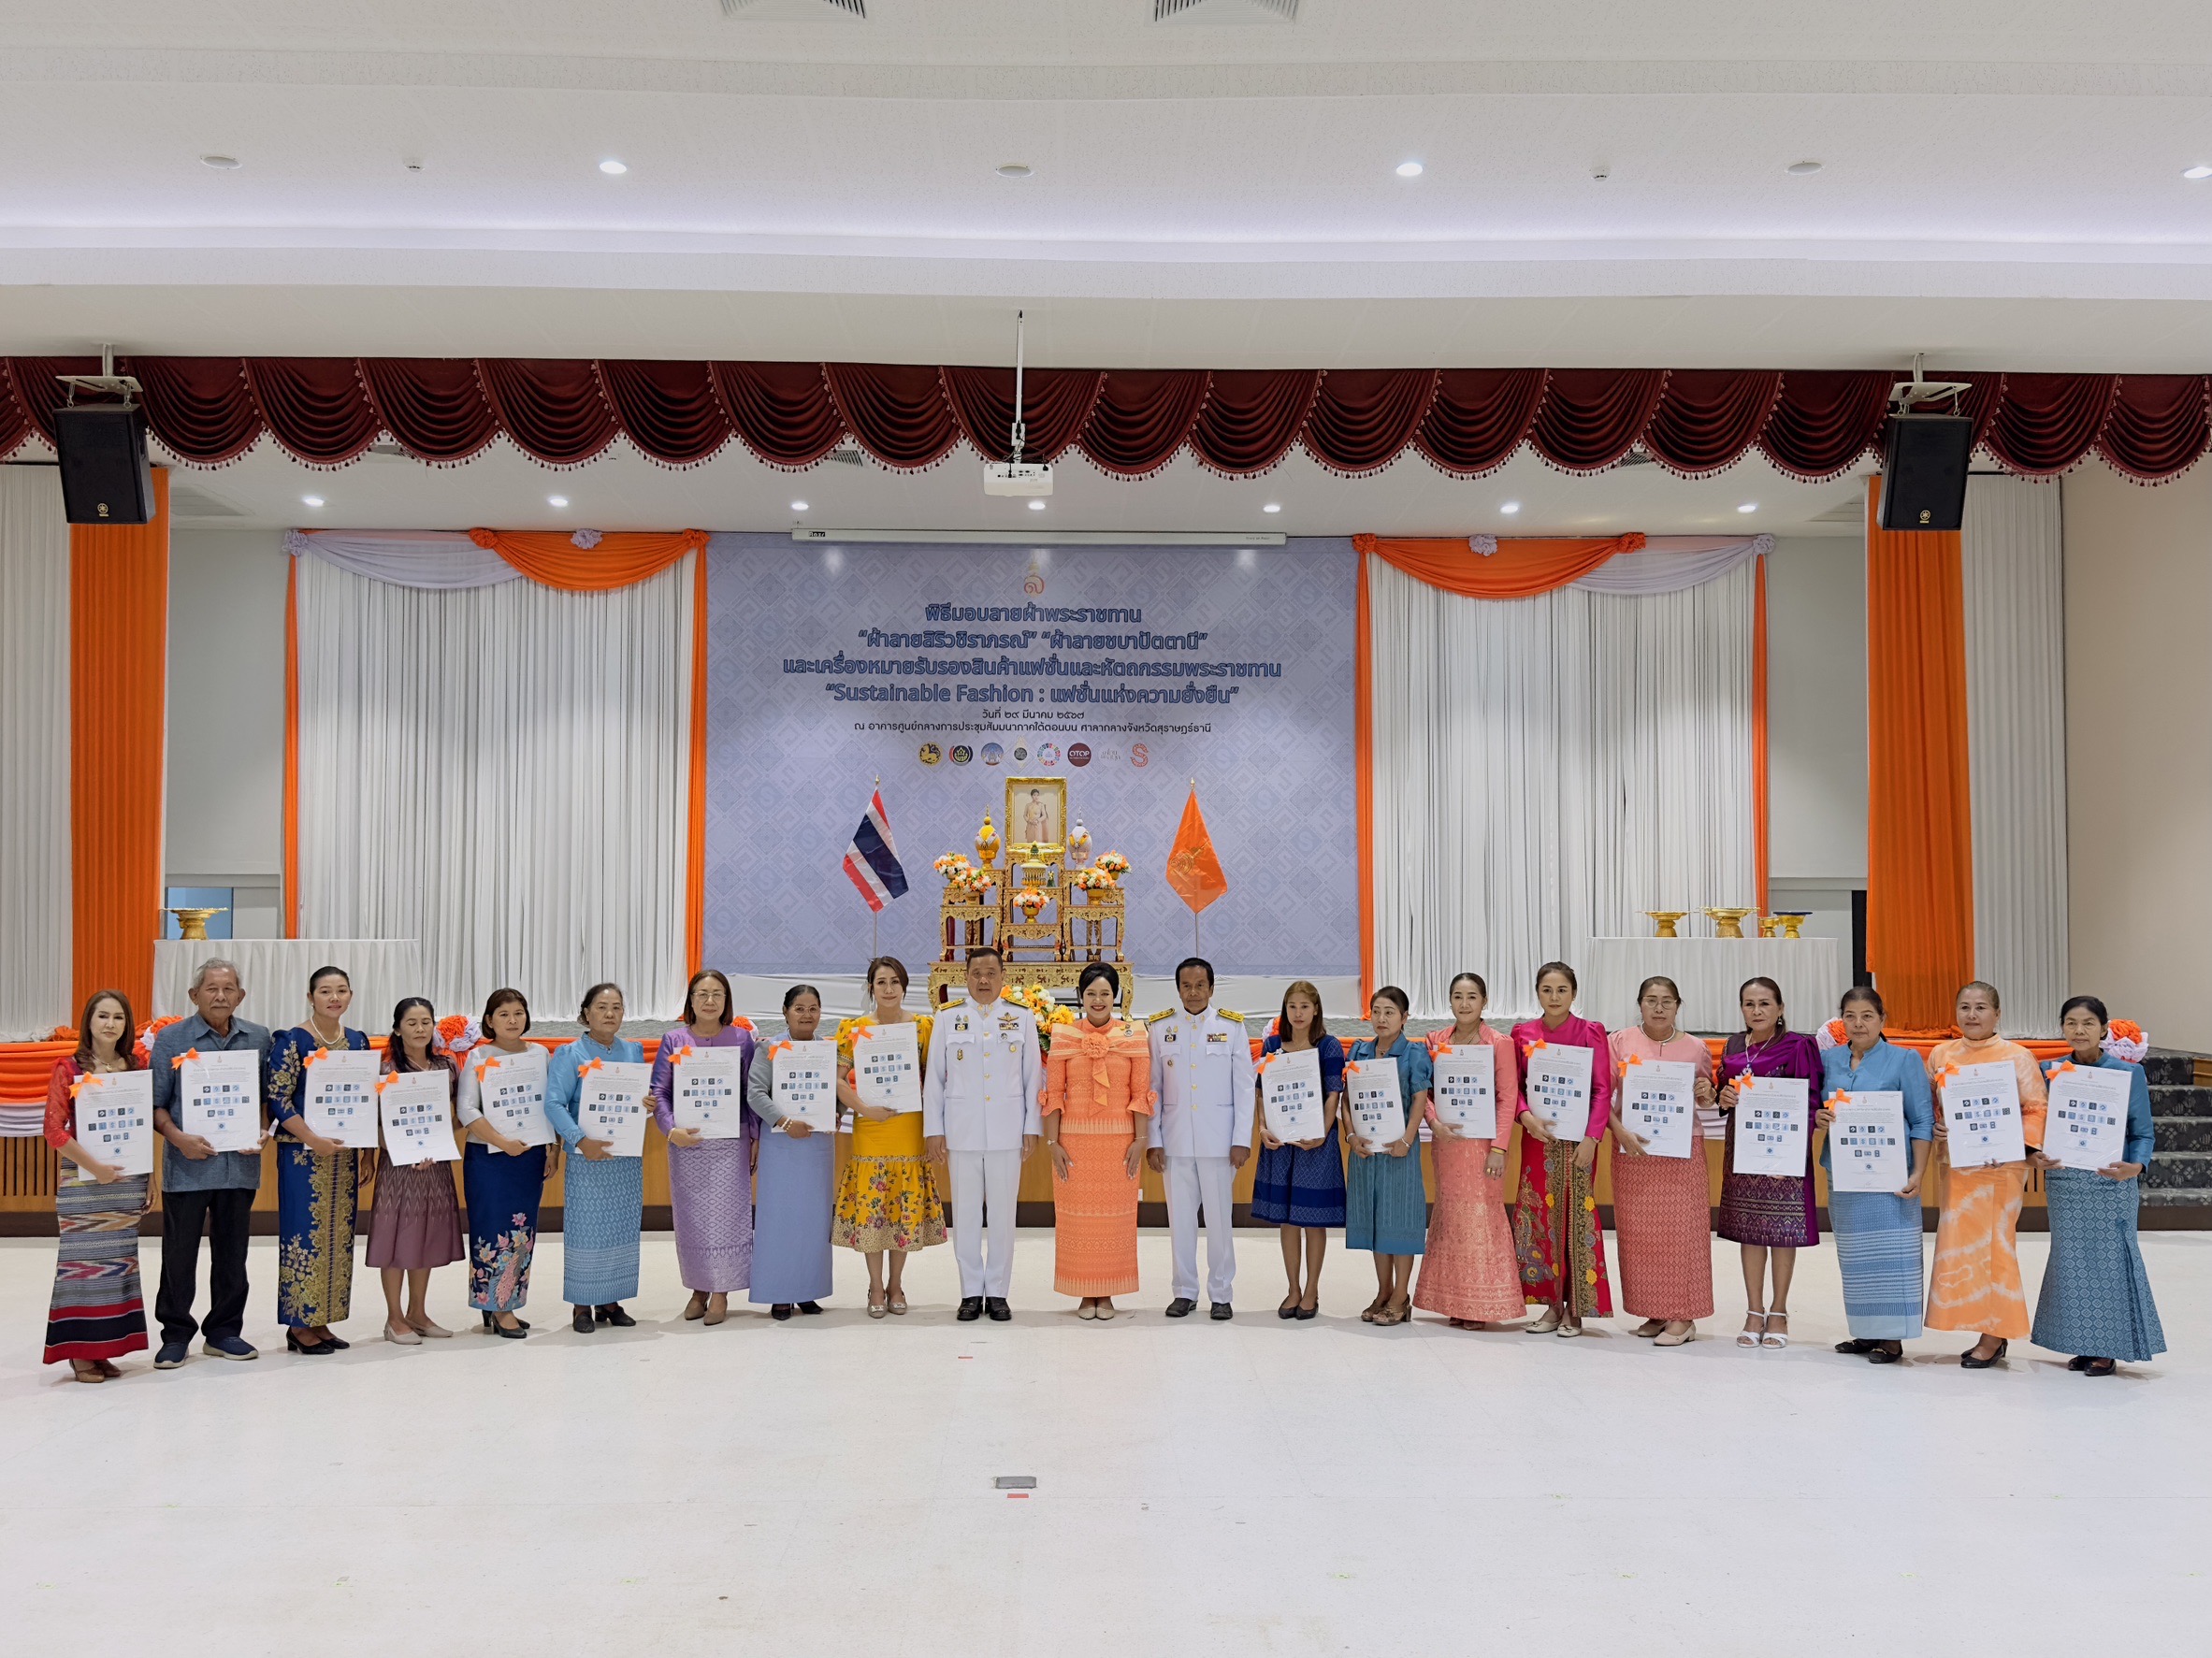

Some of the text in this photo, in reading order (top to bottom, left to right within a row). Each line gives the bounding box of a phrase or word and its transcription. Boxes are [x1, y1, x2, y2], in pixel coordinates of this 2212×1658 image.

[924, 601, 1142, 623] พิธีมอบลายผ้าพระราชทาน
[783, 651, 1281, 677] และเครื่องหมายรับรองสินค้าแฟชั่นและหัตถกรรมพระราชทาน
[825, 684, 951, 702] “Sustainable
[956, 684, 1034, 702] Fashion
[982, 706, 1085, 719] วันที่ ๒๙ มีนาคม ๒๕๖๗
[854, 721, 1211, 735] ณ อาคารศูนย์กลางการประชุมสัมมนาภาคใต้ตอนบน ศาลากลางจังหวัดสุราษฎร์ธานี
